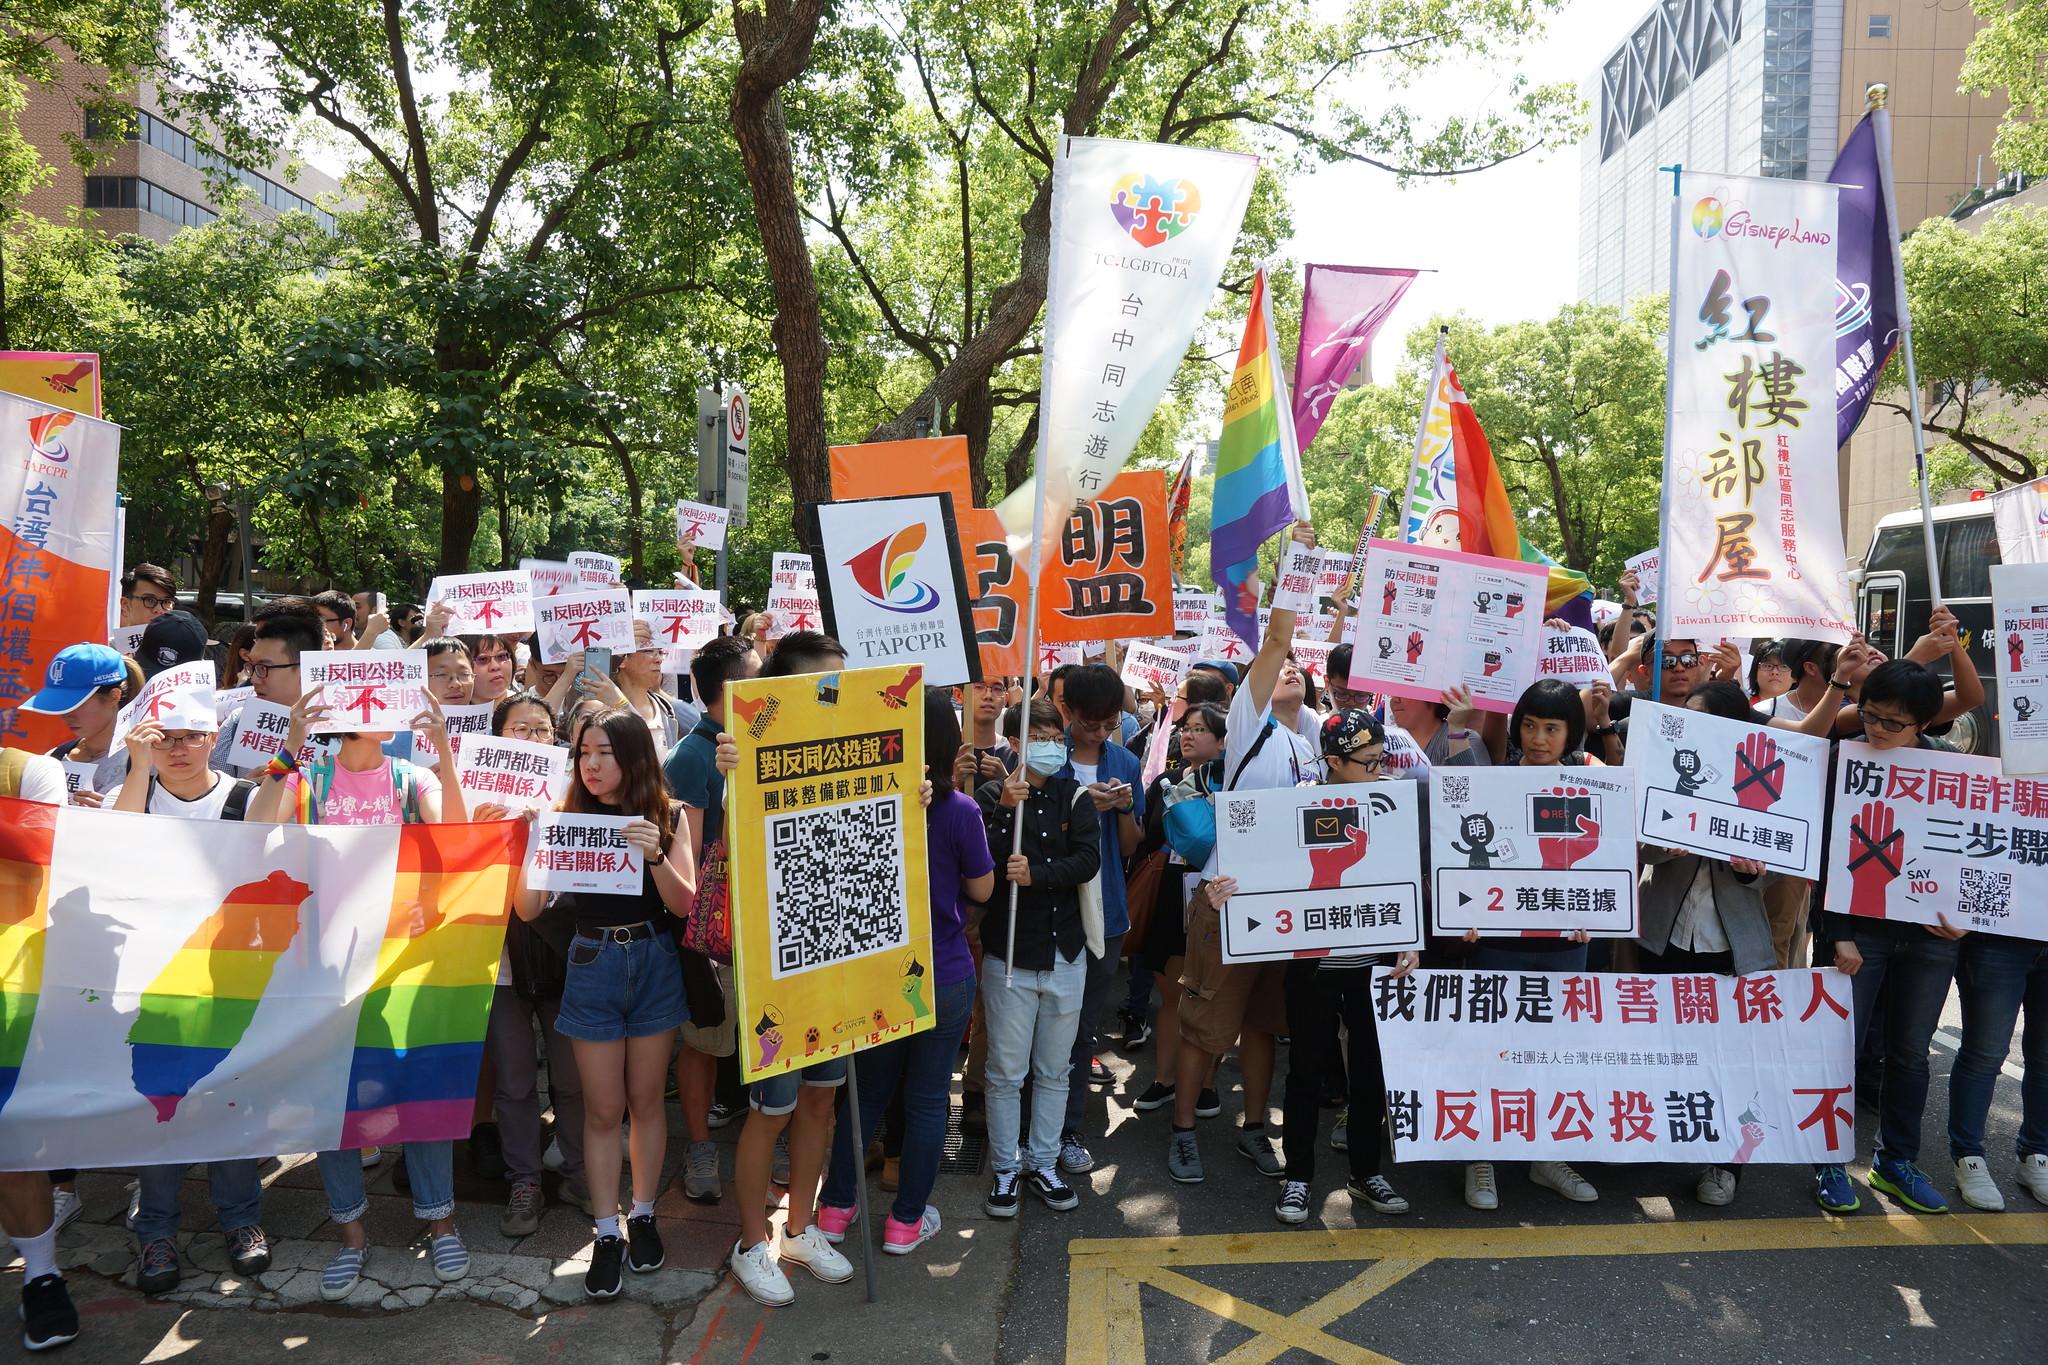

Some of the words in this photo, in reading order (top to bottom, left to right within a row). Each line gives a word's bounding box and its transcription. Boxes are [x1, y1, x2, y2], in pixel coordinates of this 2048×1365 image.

[1076, 292, 1144, 507] 台中同志遊行
[1695, 269, 1807, 583] 紅樓部屋
[24, 459, 68, 479] TAPCPR
[1776, 434, 1802, 580] 紅樓社區同志服務中心
[685, 519, 706, 539] 不
[1358, 526, 1373, 556] HOUSE
[780, 559, 814, 572] 我們都
[445, 579, 528, 600] 對反同公投說
[471, 599, 503, 629] 不
[541, 599, 626, 622] 對反同公投說
[639, 599, 716, 615] 對反同公投說
[567, 619, 602, 649] 不
[662, 616, 691, 643] 不
[789, 612, 814, 632] 不
[1675, 614, 1711, 626] Taiwan
[1714, 614, 1747, 625] LGBT
[1749, 614, 1817, 629] Community
[2004, 618, 2048, 631] 防反同
[860, 632, 947, 657] TAPCPR
[1221, 639, 1242, 659] 不
[310, 661, 422, 683] 對反同公投說
[1136, 650, 1181, 672] 我們都是
[345, 684, 387, 724] 不
[475, 747, 550, 777] 我們都是
[760, 732, 901, 780] 對反同公投說不
[1679, 753, 1694, 769] 萌
[461, 769, 553, 802] 利害關係人
[764, 772, 900, 811] 團隊整備歡迎加入
[1844, 758, 2048, 819] 防反同詐騙
[1551, 810, 1570, 819] REC
[545, 825, 628, 849] 我們都是
[1467, 818, 1487, 837] 萌
[1688, 812, 1697, 832] 1
[1709, 816, 1794, 853] 阻止連署
[1923, 817, 2048, 867] 三步驟
[534, 849, 638, 874] 利害關係人
[1907, 869, 1931, 880] SAY
[1487, 887, 1504, 912] 2
[1515, 887, 1617, 912] 蒐集證據
[1910, 881, 1938, 894] NO
[1275, 909, 1293, 934] 3
[1304, 902, 1402, 932] 回報情資
[1373, 972, 1849, 1025] 我們都是利害關係人
[1511, 1050, 1699, 1066] 社團法人台灣伴侶權益推動聯盟
[1385, 1087, 1720, 1144] 對反同公投說
[1791, 1084, 1854, 1152] 不
[1968, 1161, 1979, 1170] M
